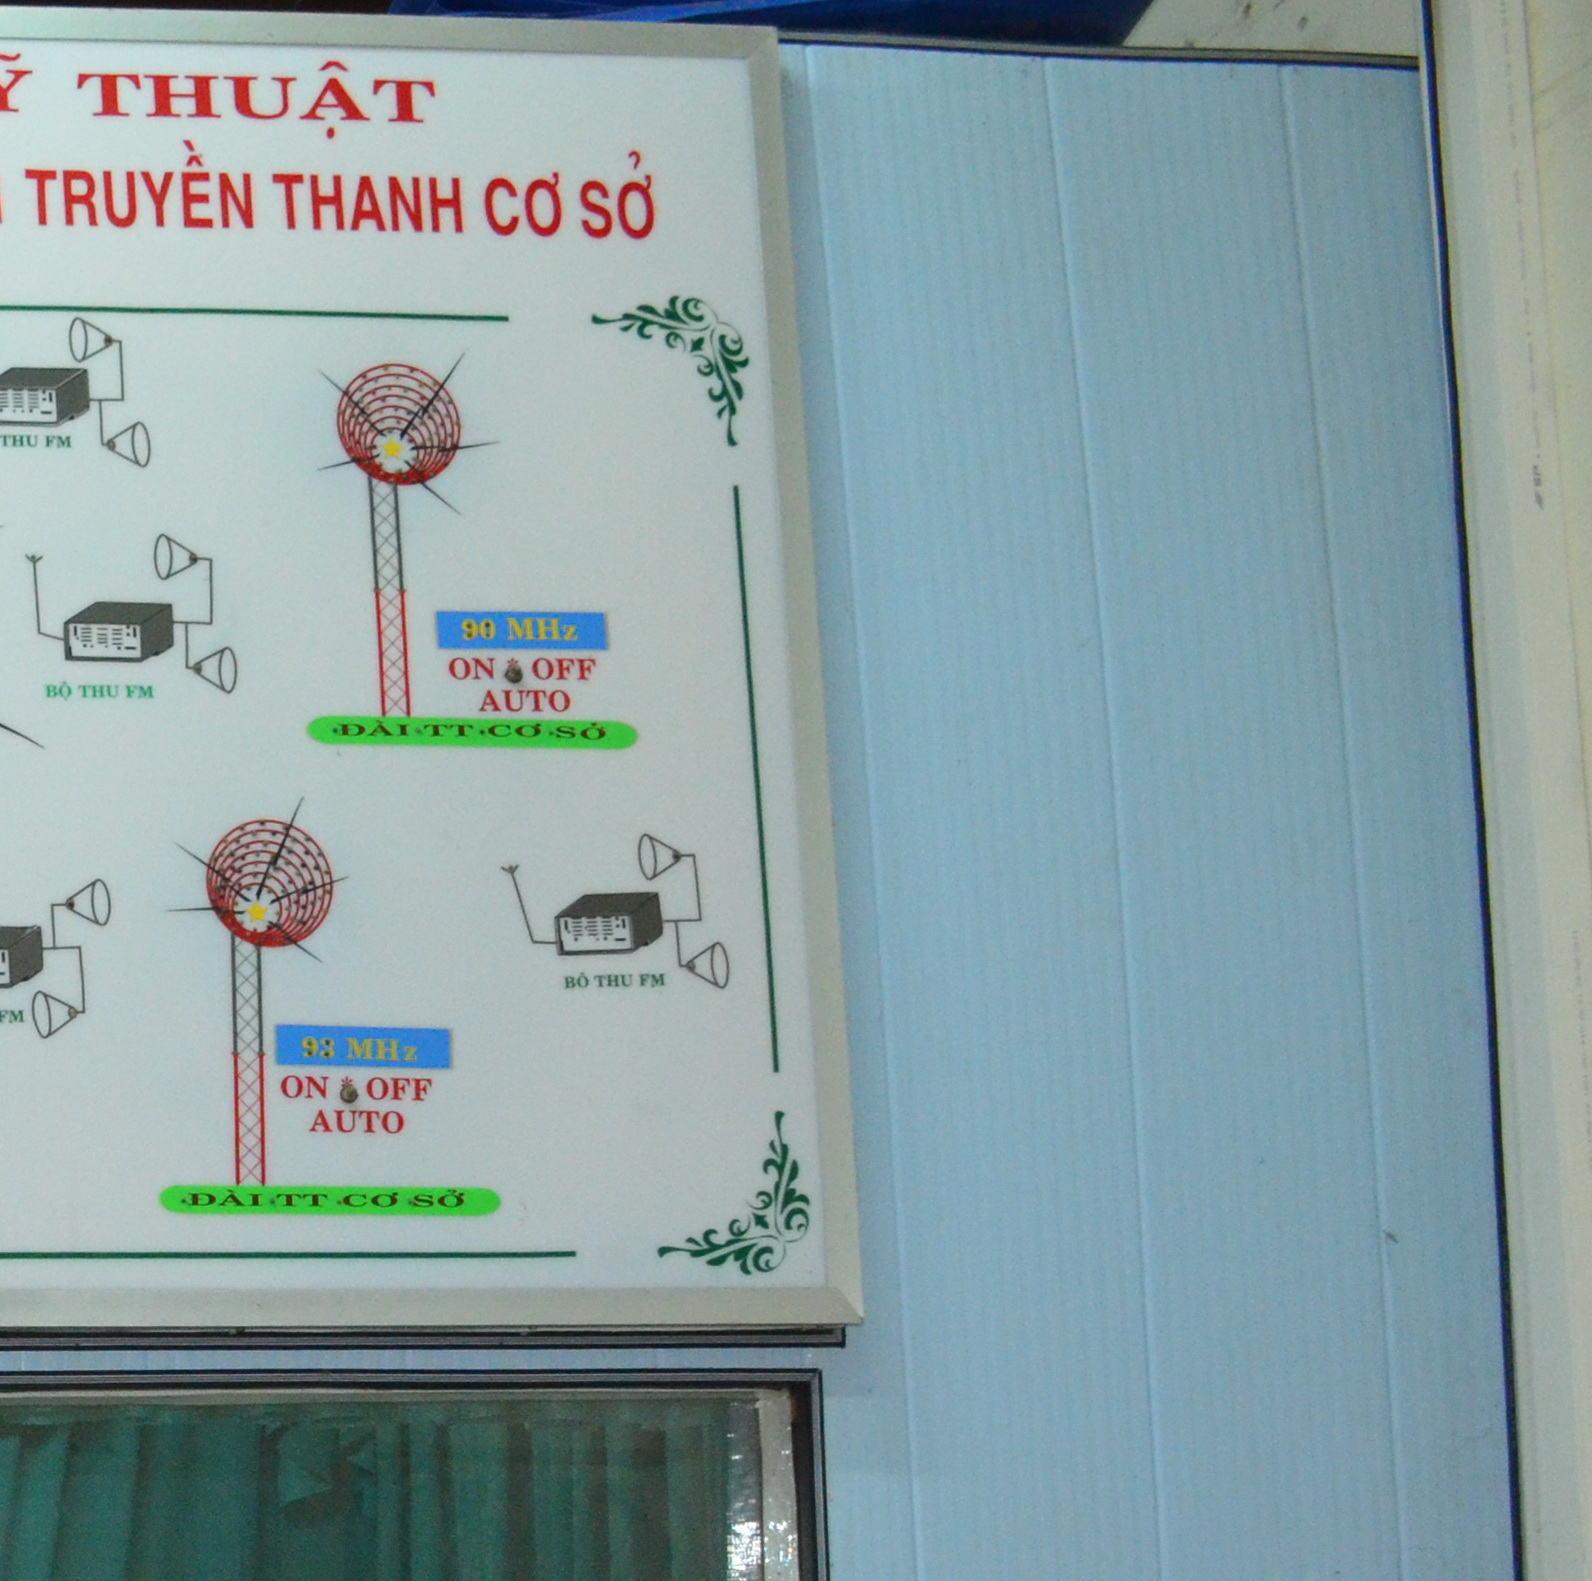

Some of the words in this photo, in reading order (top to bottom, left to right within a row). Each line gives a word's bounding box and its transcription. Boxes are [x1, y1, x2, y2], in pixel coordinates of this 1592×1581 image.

[77, 61, 437, 139] THUẬT
[24, 140, 255, 230] TRUYỀN
[272, 173, 463, 234] THANH
[485, 176, 562, 237] CƠ
[581, 151, 655, 241] SỞ
[0, 434, 38, 447] THU
[45, 435, 72, 448] FM
[462, 619, 496, 639] 90
[507, 618, 578, 641] MHz
[449, 658, 495, 680] ON
[532, 658, 597, 681] OFF
[45, 681, 72, 700] BỘ
[78, 684, 119, 698] THU
[126, 685, 154, 699] FM
[479, 690, 571, 713] AUTO
[424, 724, 473, 737] TT
[594, 974, 632, 987] THU
[639, 973, 665, 987] FM
[301, 1036, 335, 1059] 93
[346, 1037, 418, 1062] MHz
[281, 1075, 329, 1099] ON
[366, 1076, 433, 1101] OFF
[309, 1110, 405, 1134] AUTO
[187, 1189, 262, 1207] ĐÀI
[277, 1193, 328, 1207] TT
[343, 1191, 398, 1207] CƠ
